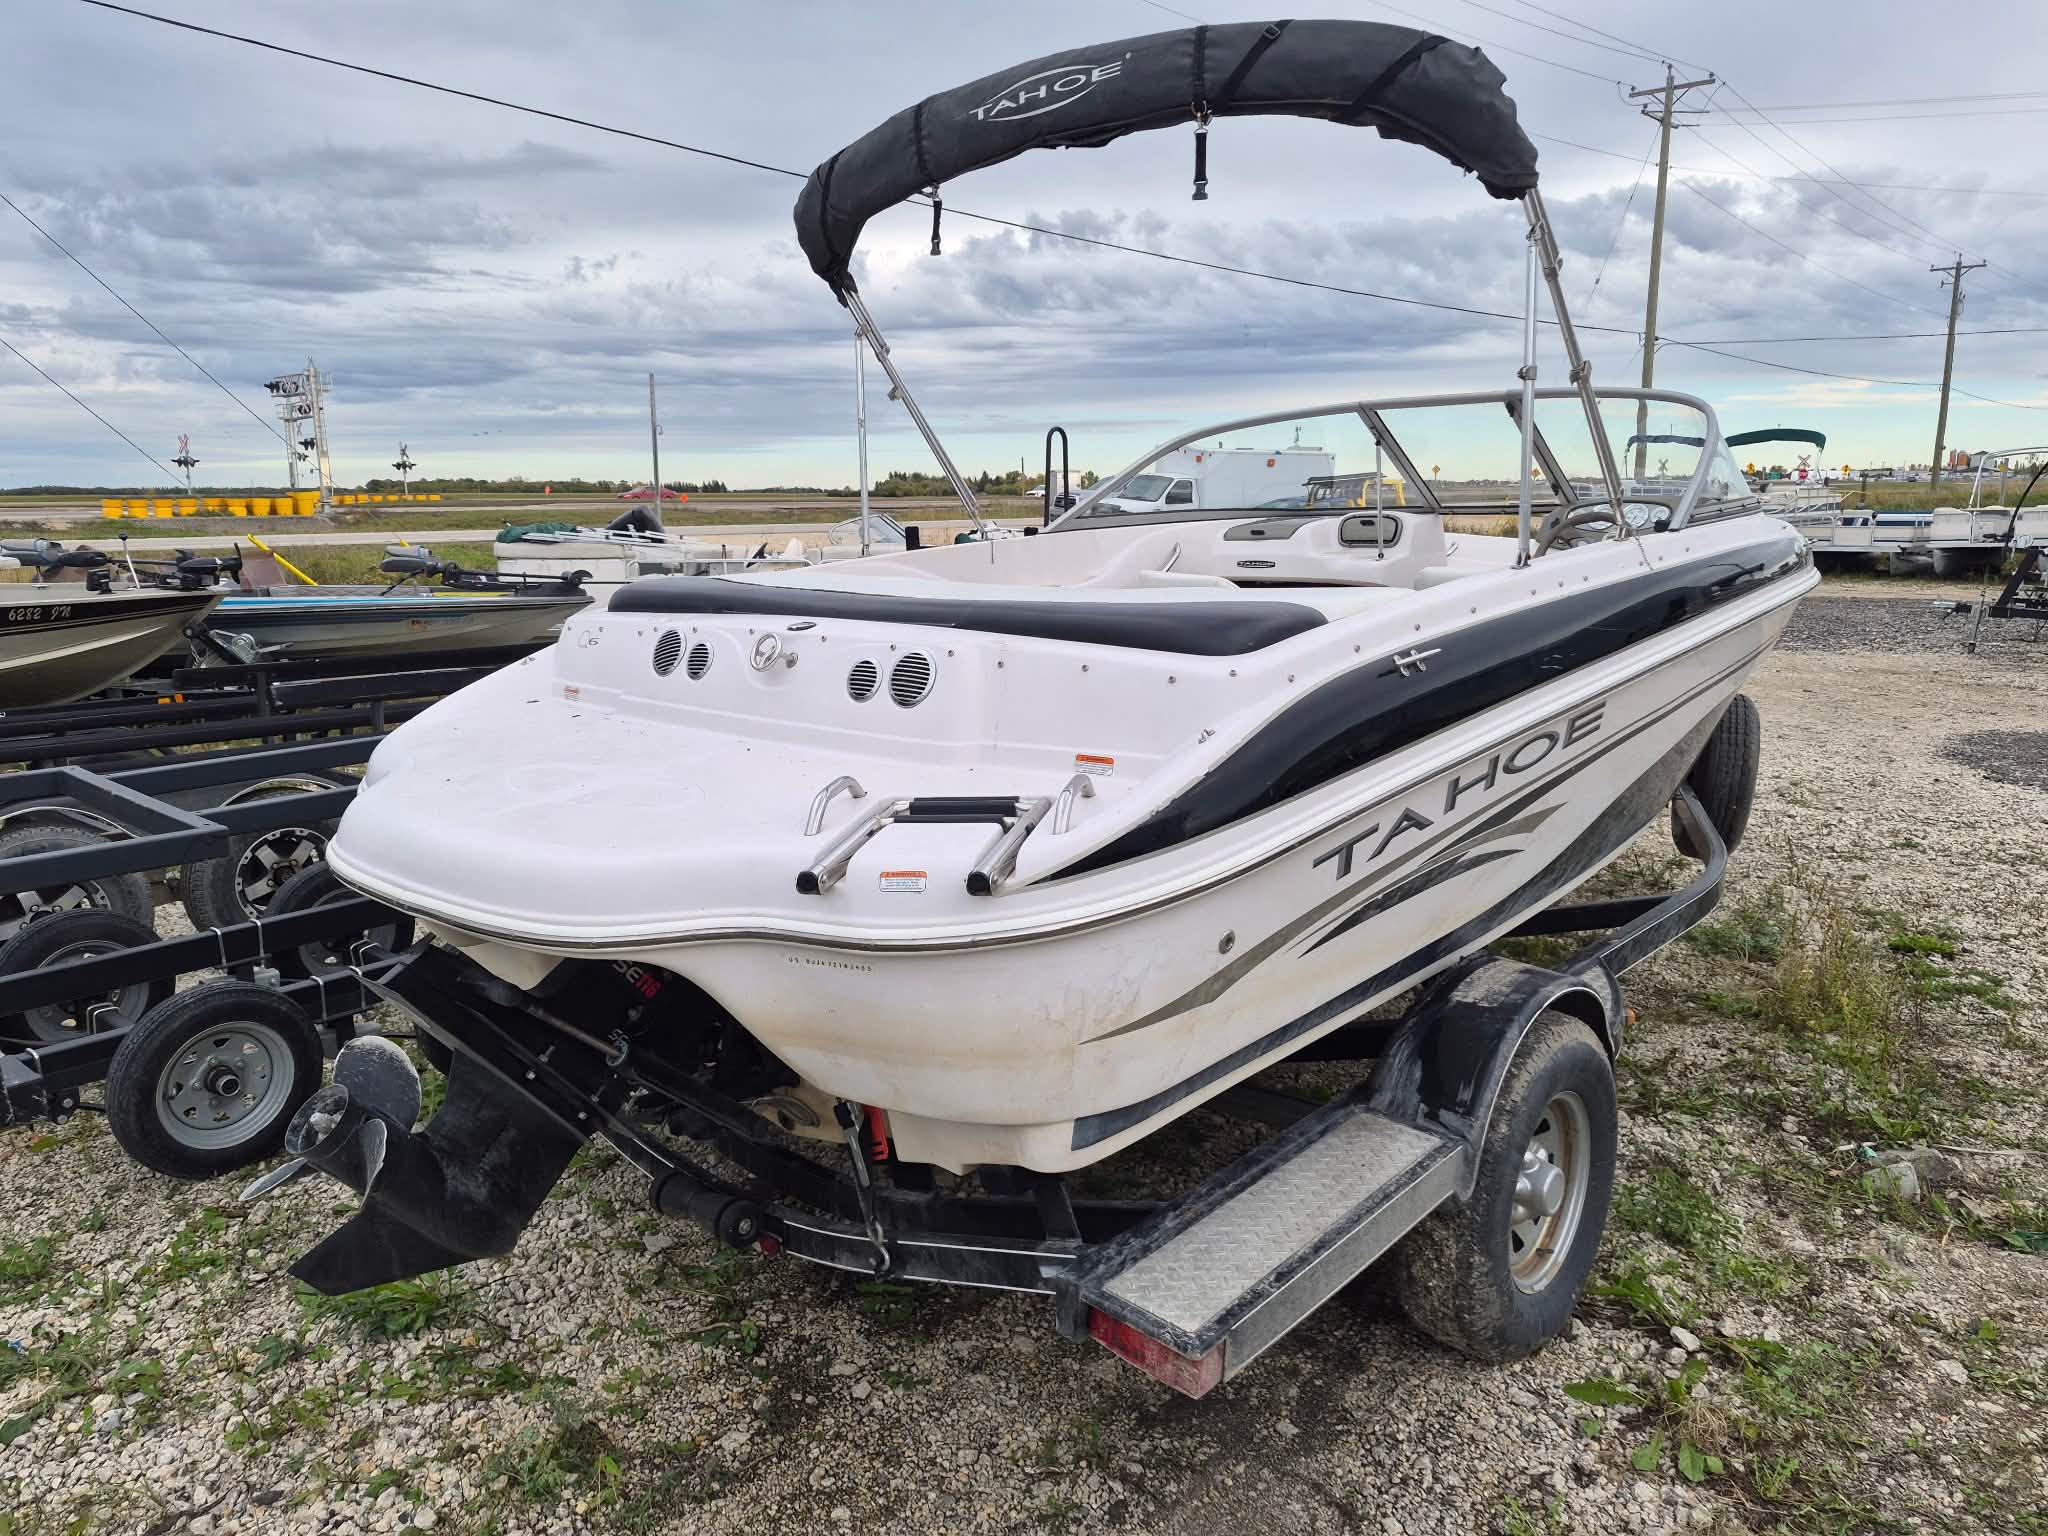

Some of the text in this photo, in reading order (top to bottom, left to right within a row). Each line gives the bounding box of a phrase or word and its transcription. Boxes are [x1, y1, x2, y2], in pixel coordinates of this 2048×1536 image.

[968, 61, 1122, 121] TAHOE
[8, 608, 42, 620] 6282
[1312, 701, 1606, 880] TAHOE
